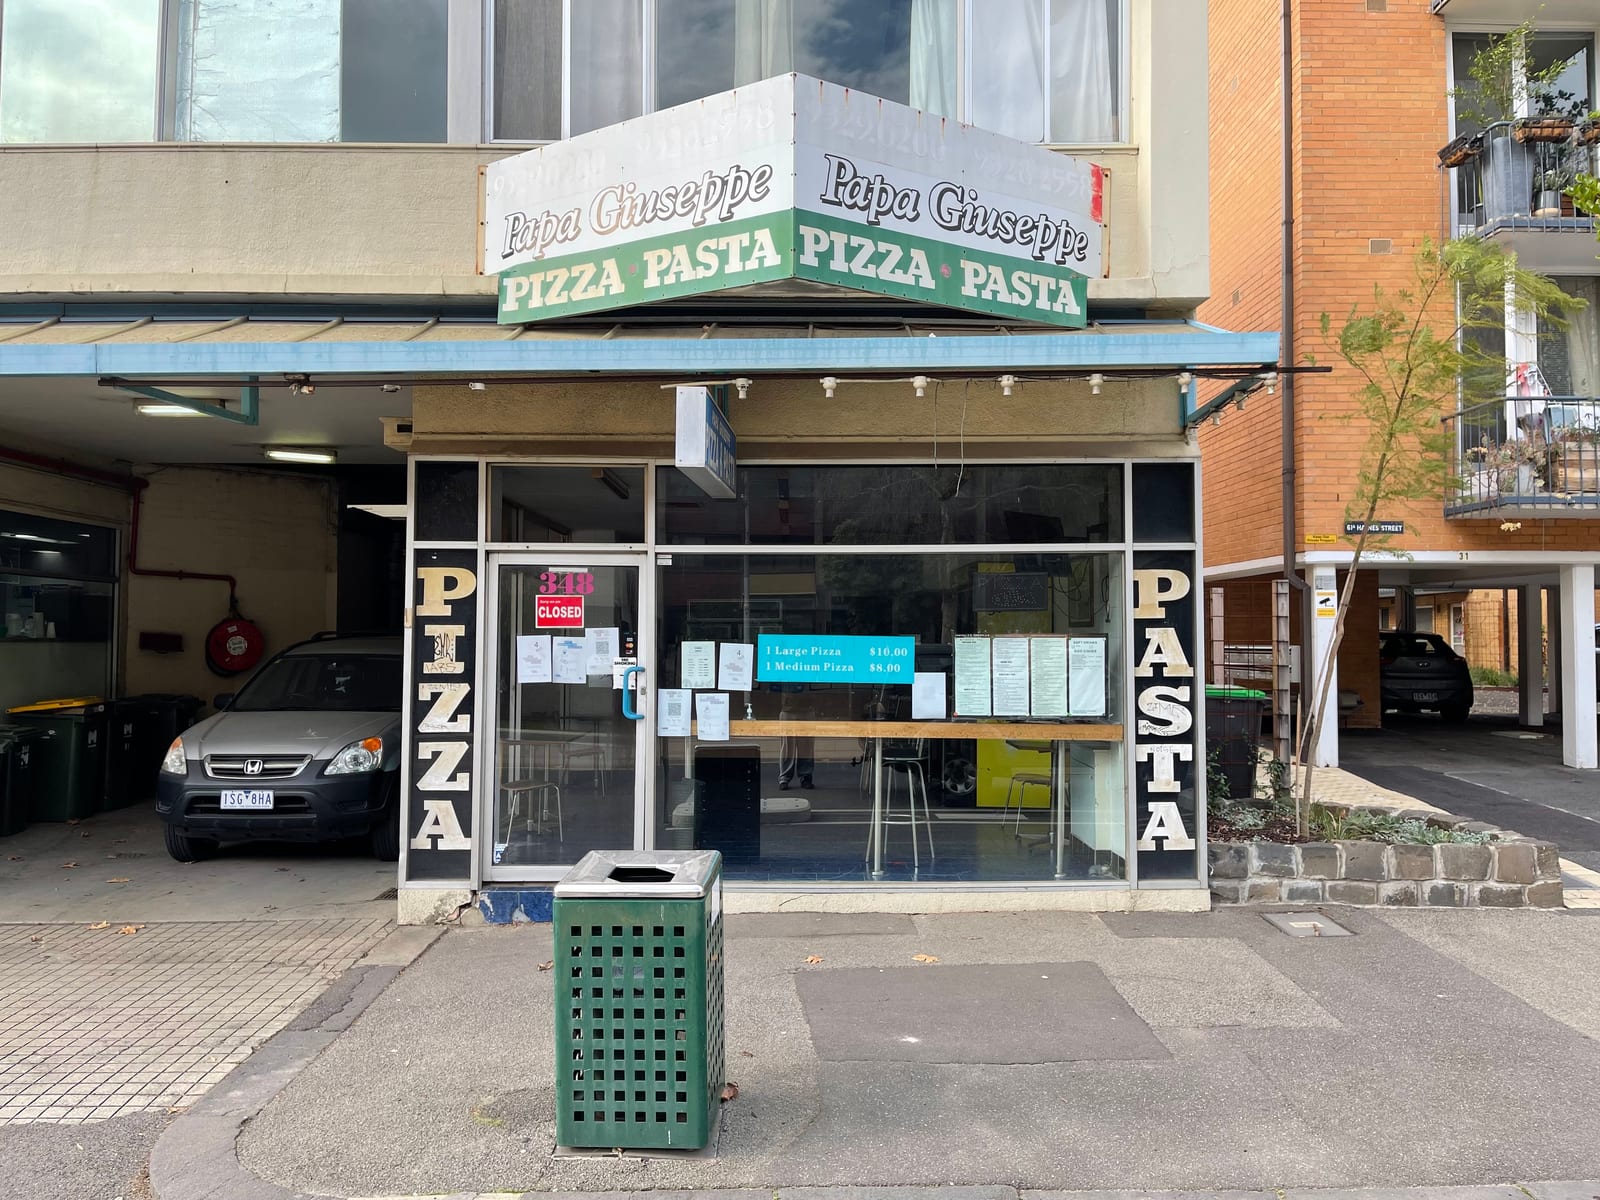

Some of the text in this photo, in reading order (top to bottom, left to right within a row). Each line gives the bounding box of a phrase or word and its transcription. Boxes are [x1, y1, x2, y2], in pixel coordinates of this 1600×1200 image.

[501, 208, 581, 260] Papa
[588, 164, 773, 236] Giuseppe
[821, 154, 1088, 264] Papa Giuseppe
[502, 228, 782, 312] PIZZA PASTA
[800, 225, 1081, 316] PIZZA PASTA
[1381, 524, 1403, 532] STREET
[539, 571, 594, 594] 348
[1459, 552, 1469, 561] 31
[538, 606, 582, 618] CLOSED
[766, 662, 901, 672] 1 Medium Pizza $8.00
[775, 646, 808, 657] Large
[811, 647, 841, 656] Pizza
[869, 647, 908, 657] $10.00
[411, 566, 477, 850] PIZZA
[1134, 569, 1196, 851] PASTA
